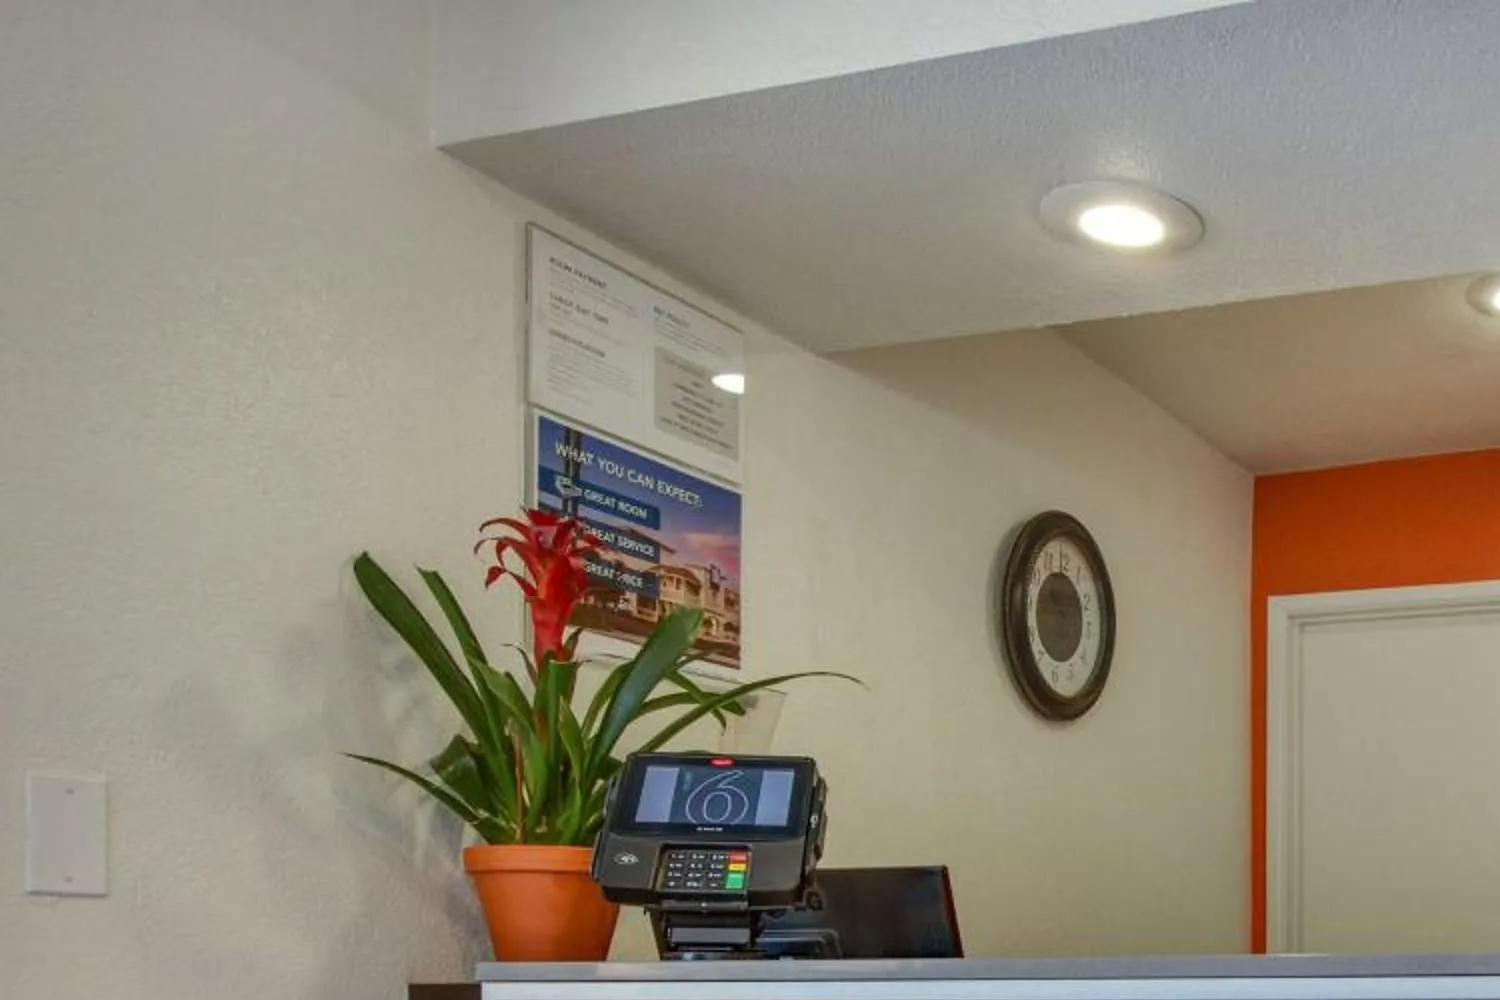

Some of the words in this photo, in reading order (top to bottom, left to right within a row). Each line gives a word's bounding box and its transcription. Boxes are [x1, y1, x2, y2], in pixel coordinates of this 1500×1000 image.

[555, 440, 594, 465] WHAT
[597, 455, 624, 478] YOU
[627, 469, 654, 489] CAN
[583, 489, 615, 508] GREAT
[618, 501, 647, 519] ROOM
[617, 535, 655, 557] SERVICE
[685, 769, 749, 825] 6
